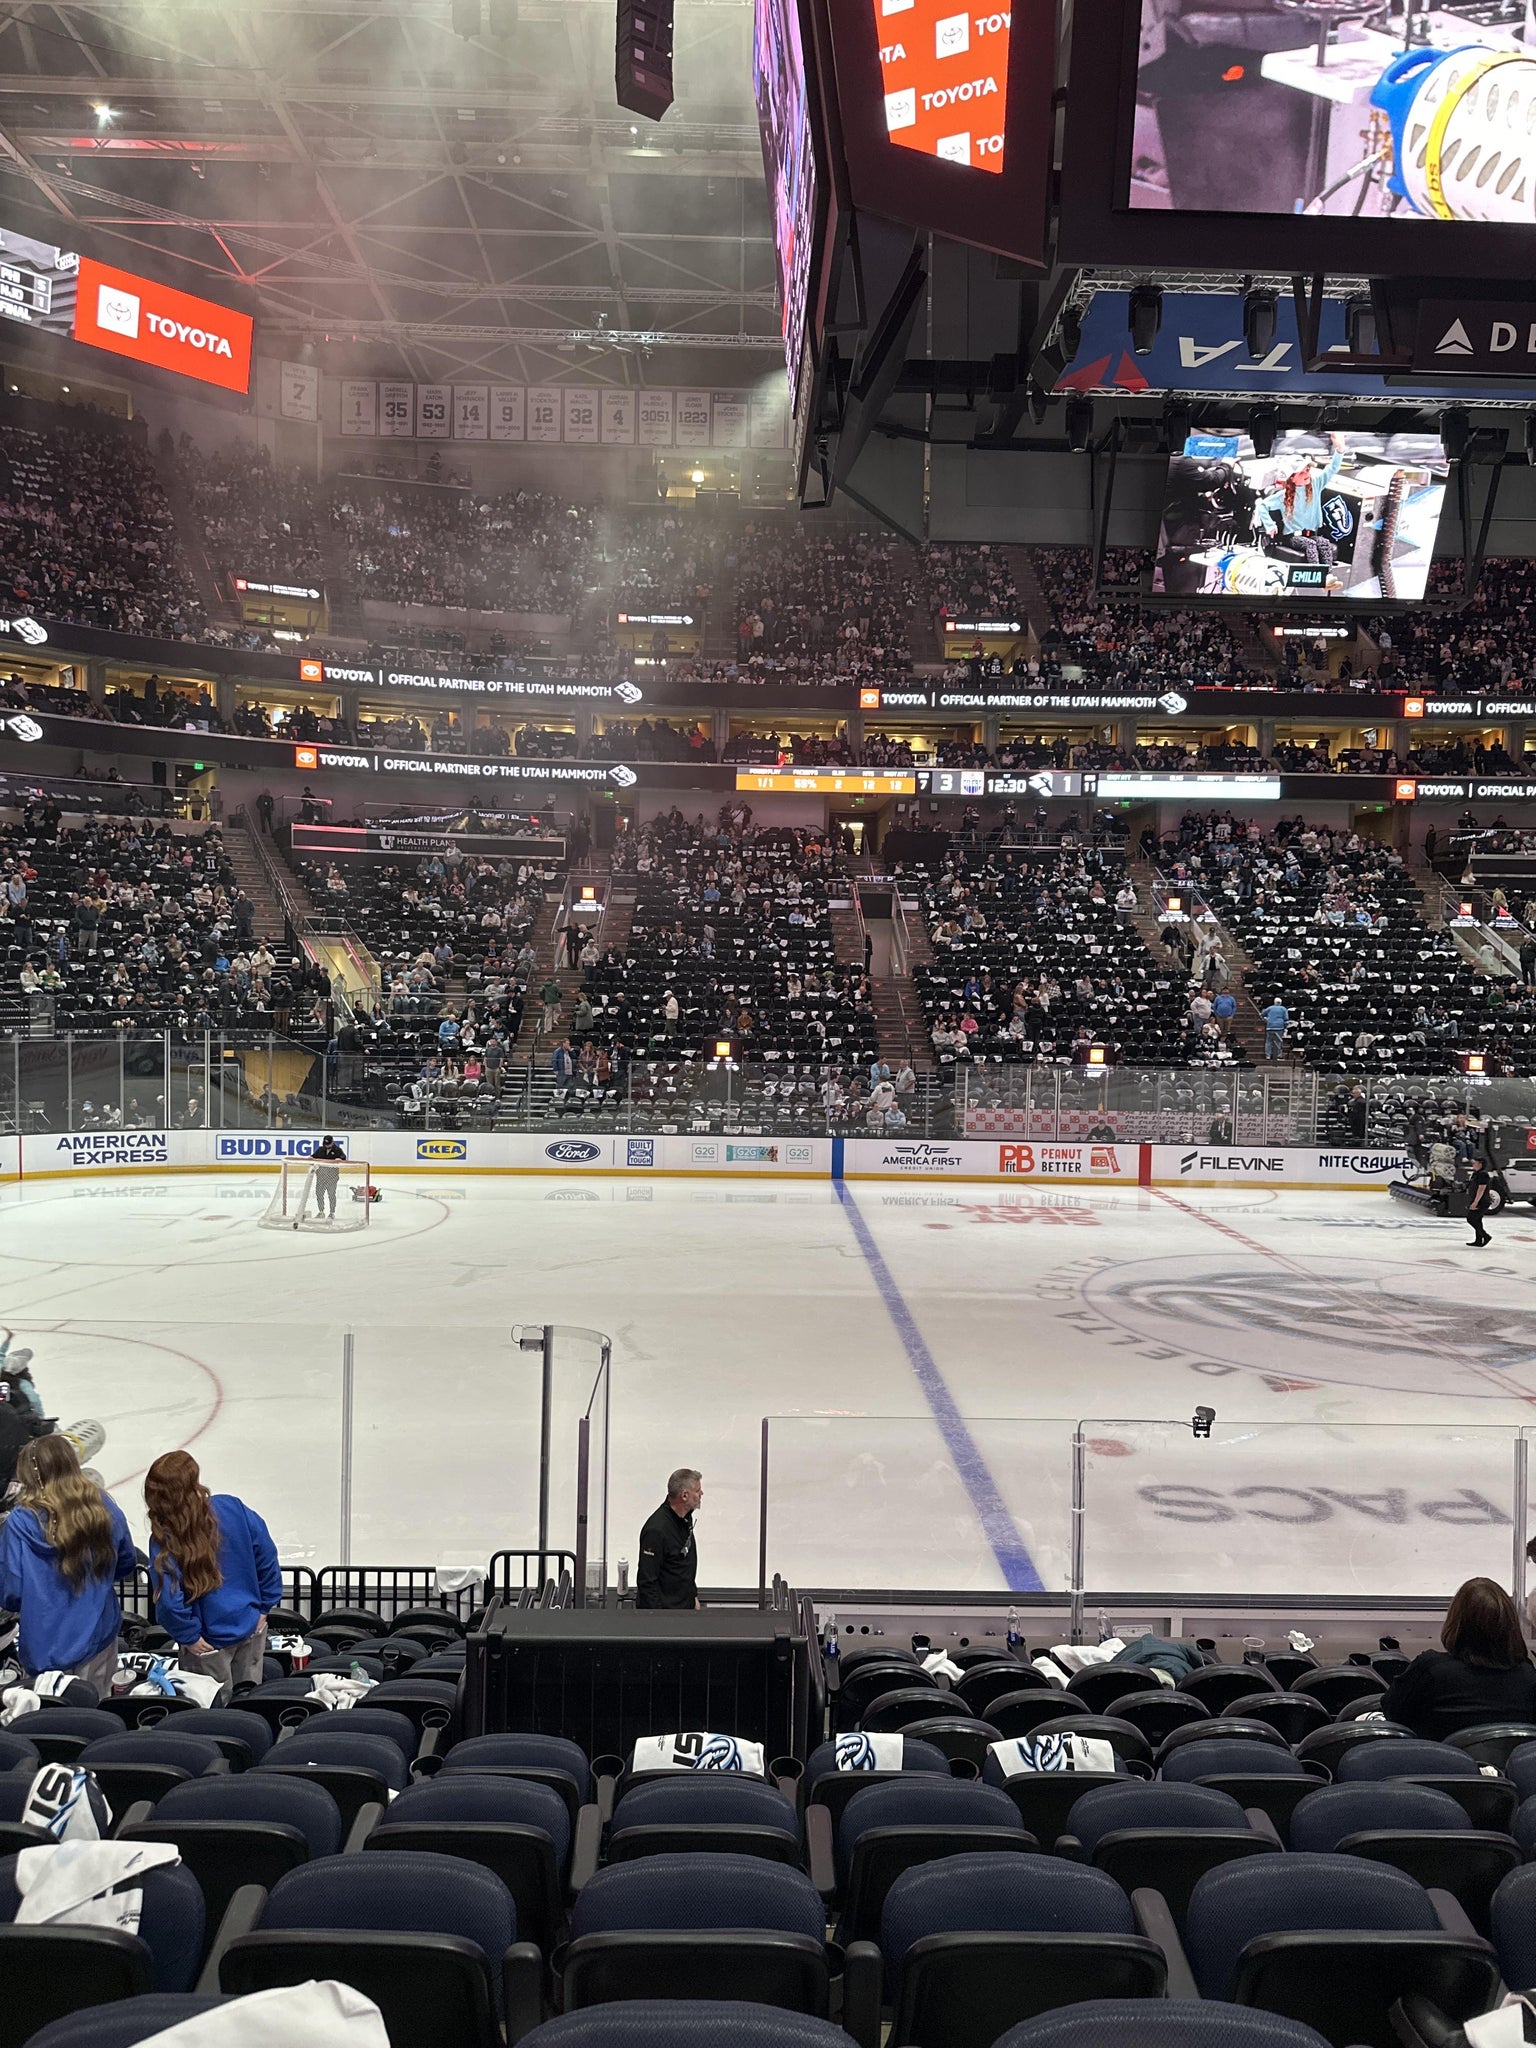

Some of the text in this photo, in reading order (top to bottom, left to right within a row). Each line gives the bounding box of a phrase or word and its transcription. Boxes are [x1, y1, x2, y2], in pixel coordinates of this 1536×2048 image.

[879, 43, 906, 64] TA
[921, 76, 998, 110] TOYOTA
[38, 280, 46, 292] 5
[146, 312, 232, 358] TOYOTA
[293, 384, 306, 400] 7
[356, 400, 362, 416] 1
[386, 402, 408, 418] 35
[423, 404, 444, 420] 53
[462, 405, 479, 421] 14
[502, 406, 513, 422] 9
[536, 407, 552, 423] 12
[570, 408, 592, 424] 32
[614, 410, 623, 425] 4
[641, 410, 670, 422] 3051
[678, 412, 708, 424] 1223
[1292, 571, 1322, 583] EMILIA
[324, 666, 612, 696] TOYOTA OFFICIAL PARTNER OF THE UTAH MAMMOTH
[882, 694, 1156, 708] TOYOTA OFFICIAL PARTNER OF THE UTAH MAMMOTH
[1426, 702, 1533, 714] TOYOTA OFFICIAL
[320, 753, 606, 780] TOYOTA OFFICIAL PARTNER OF THE UTAH MAMMOTH
[758, 778, 774, 788] 1/1
[835, 780, 842, 790] 2
[863, 780, 875, 790] 12
[890, 780, 902, 790] 12
[920, 780, 928, 790] 7
[940, 774, 952, 791] 3
[987, 780, 1026, 792] 12:30
[1064, 776, 1072, 792] 1
[1084, 782, 1096, 792] 11
[1418, 785, 1464, 796] TOYOTA
[1478, 786, 1525, 796] OFFICIAL
[397, 838, 428, 846] HEALTH
[207, 860, 215, 869] 11
[56, 1134, 166, 1150] AMERICAN
[222, 1139, 271, 1156] BUD
[74, 1150, 168, 1164] EXPRESS
[556, 1144, 590, 1158] Ford
[695, 1147, 714, 1155] G2G
[789, 1148, 809, 1156] G2G
[1000, 1144, 1034, 1172] PB
[1041, 1148, 1082, 1159] PEANUT
[882, 1156, 962, 1166] AMERICA FIRST
[1006, 1161, 1016, 1172] fit
[1042, 1162, 1082, 1172] BETTER
[1200, 1156, 1284, 1171] FILEVINE
[968, 1214, 1102, 1226] SEAT
[1055, 1310, 1240, 1376] DELTA
